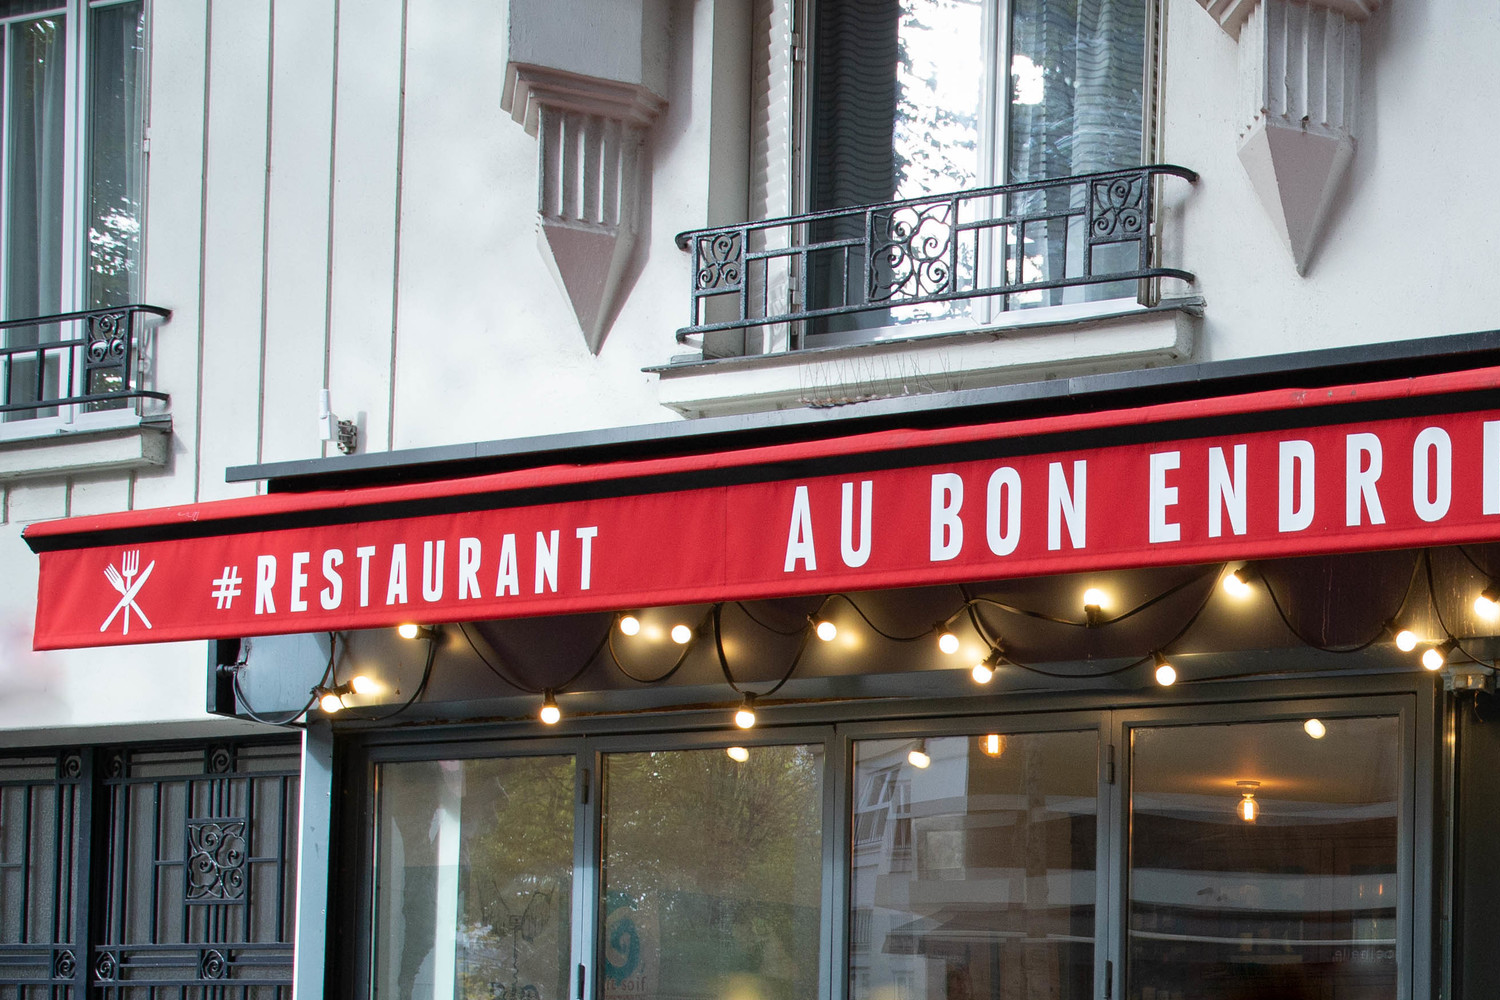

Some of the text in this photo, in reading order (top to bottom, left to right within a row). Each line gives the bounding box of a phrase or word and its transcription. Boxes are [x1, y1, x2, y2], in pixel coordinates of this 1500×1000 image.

[783, 480, 873, 573] AU
[929, 459, 1087, 562] BON
[211, 525, 599, 615] #RESTAURANT
[621, 976, 647, 991] soif
